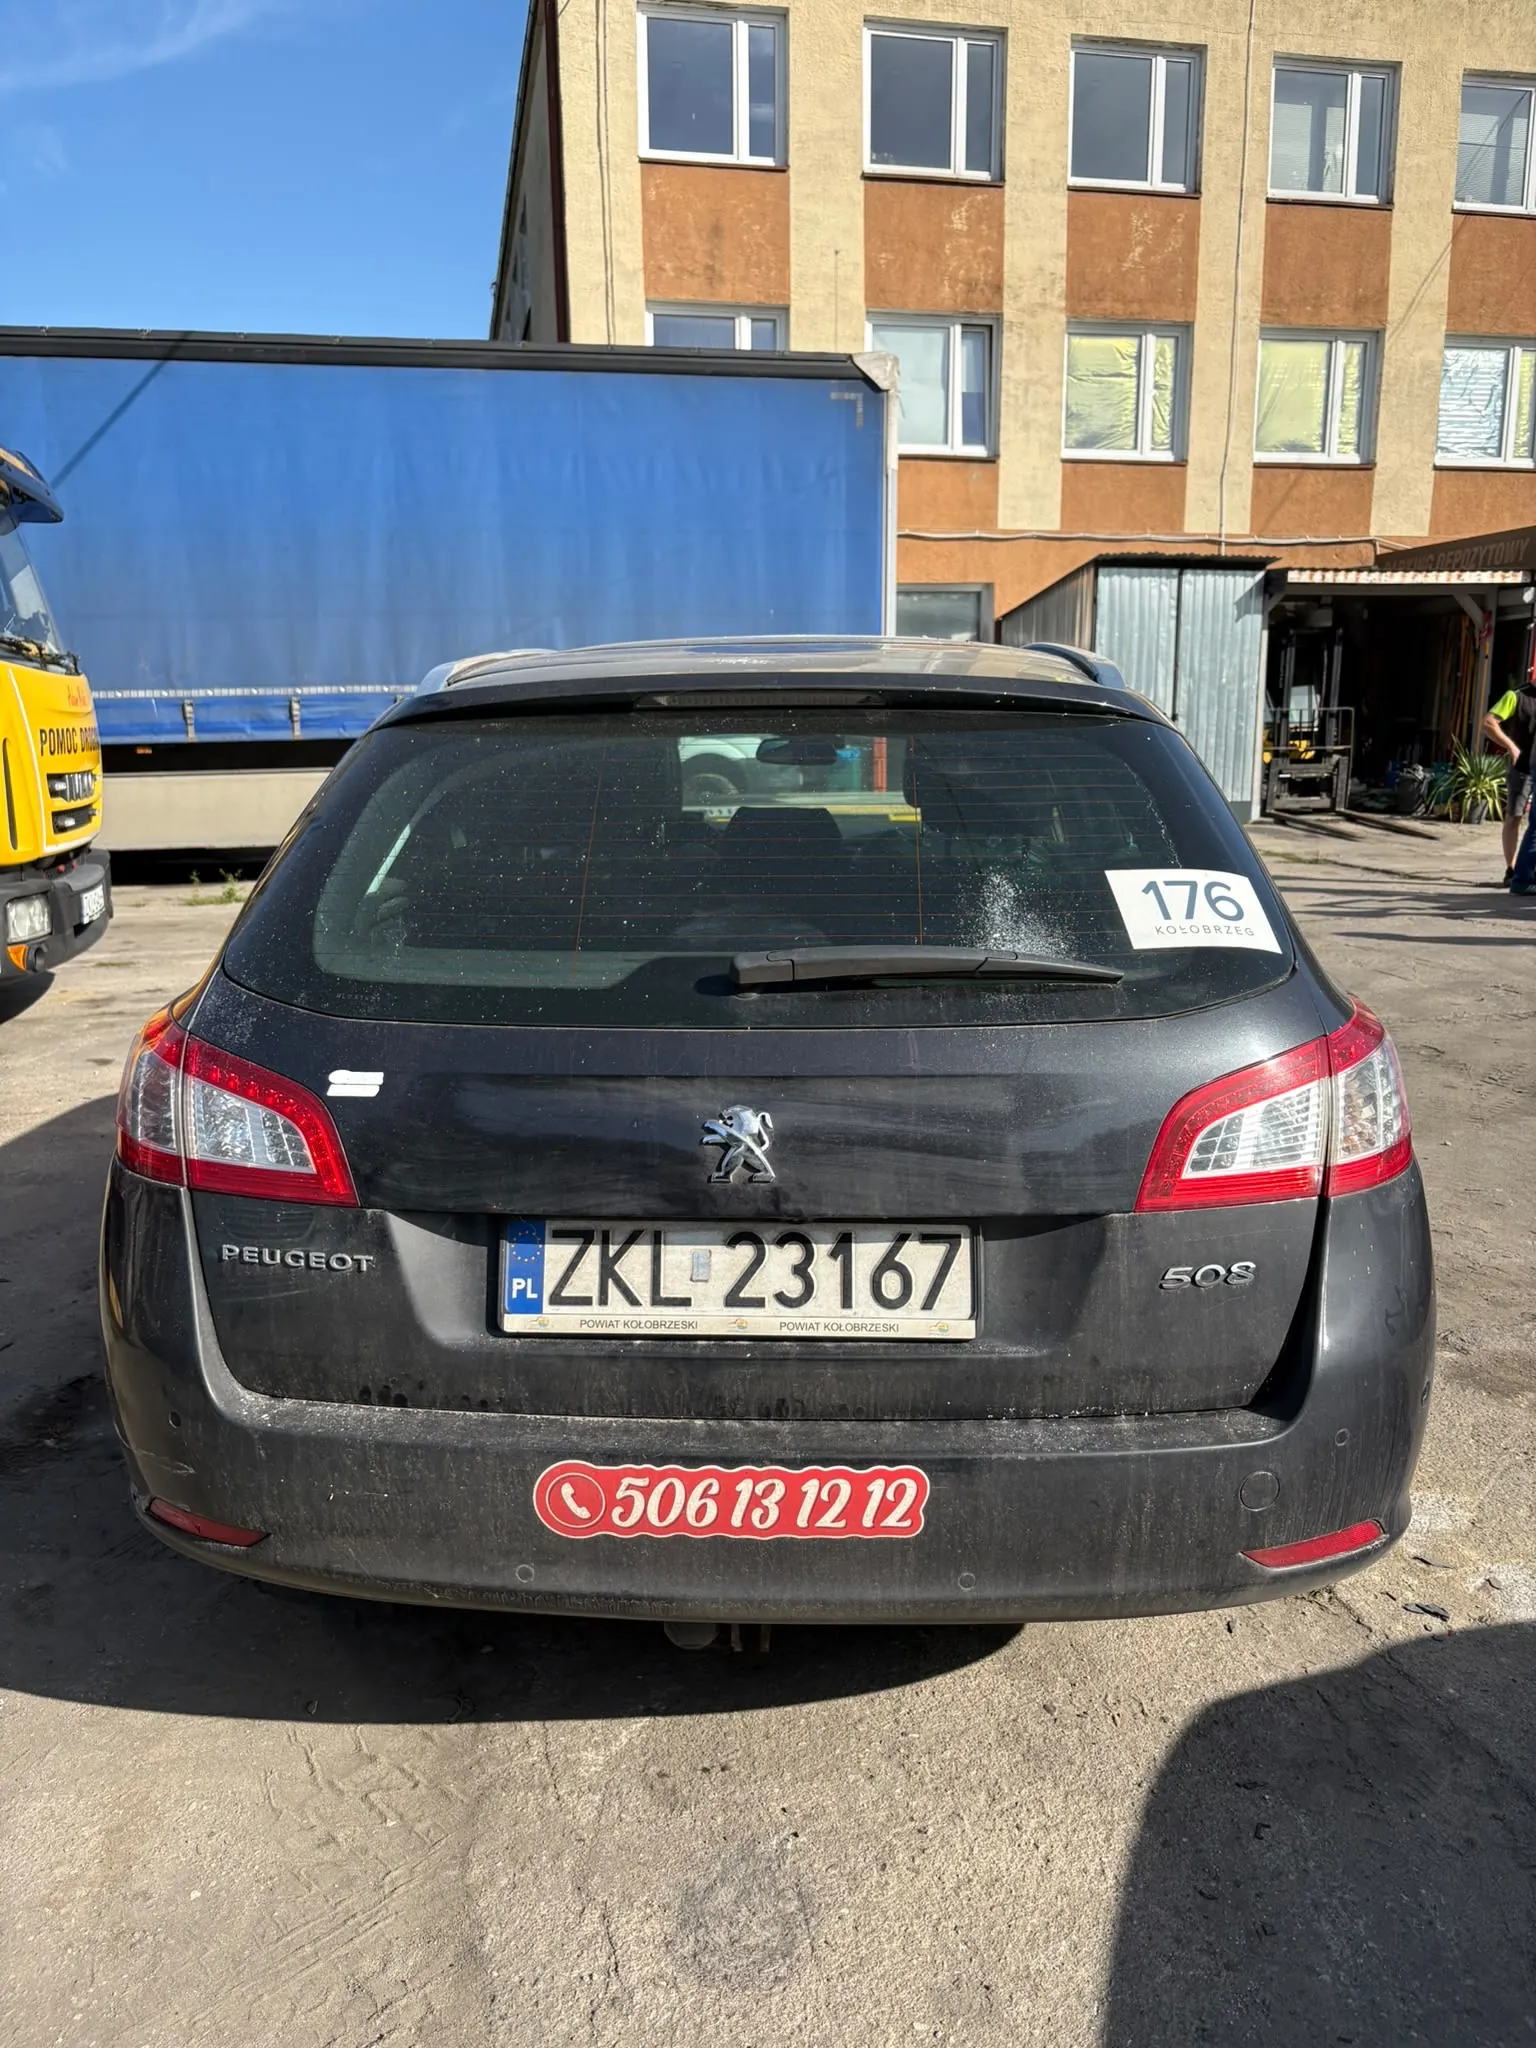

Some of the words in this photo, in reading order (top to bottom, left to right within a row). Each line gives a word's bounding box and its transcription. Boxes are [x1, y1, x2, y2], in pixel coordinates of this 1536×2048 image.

[1435, 538, 1531, 570] DEPOZYTOWY
[39, 727, 78, 757] POMOC
[1141, 880, 1245, 922] 176
[1155, 924, 1255, 937] KOŁOBRZEG
[221, 1244, 374, 1272] PEUGEOT
[548, 1228, 693, 1308] ZKL
[722, 1230, 964, 1311] 23167
[511, 1278, 538, 1299] PL
[1159, 1260, 1257, 1290] 508
[579, 1319, 621, 1329] POWIAT
[623, 1319, 698, 1330] KOŁOBRZESKI
[779, 1321, 821, 1331] POWIAT
[823, 1322, 900, 1332] KOŁOBRZESKI
[611, 1476, 720, 1529] 506
[730, 1477, 787, 1530] 13
[796, 1477, 853, 1528] 12
[861, 1477, 916, 1528] 12
